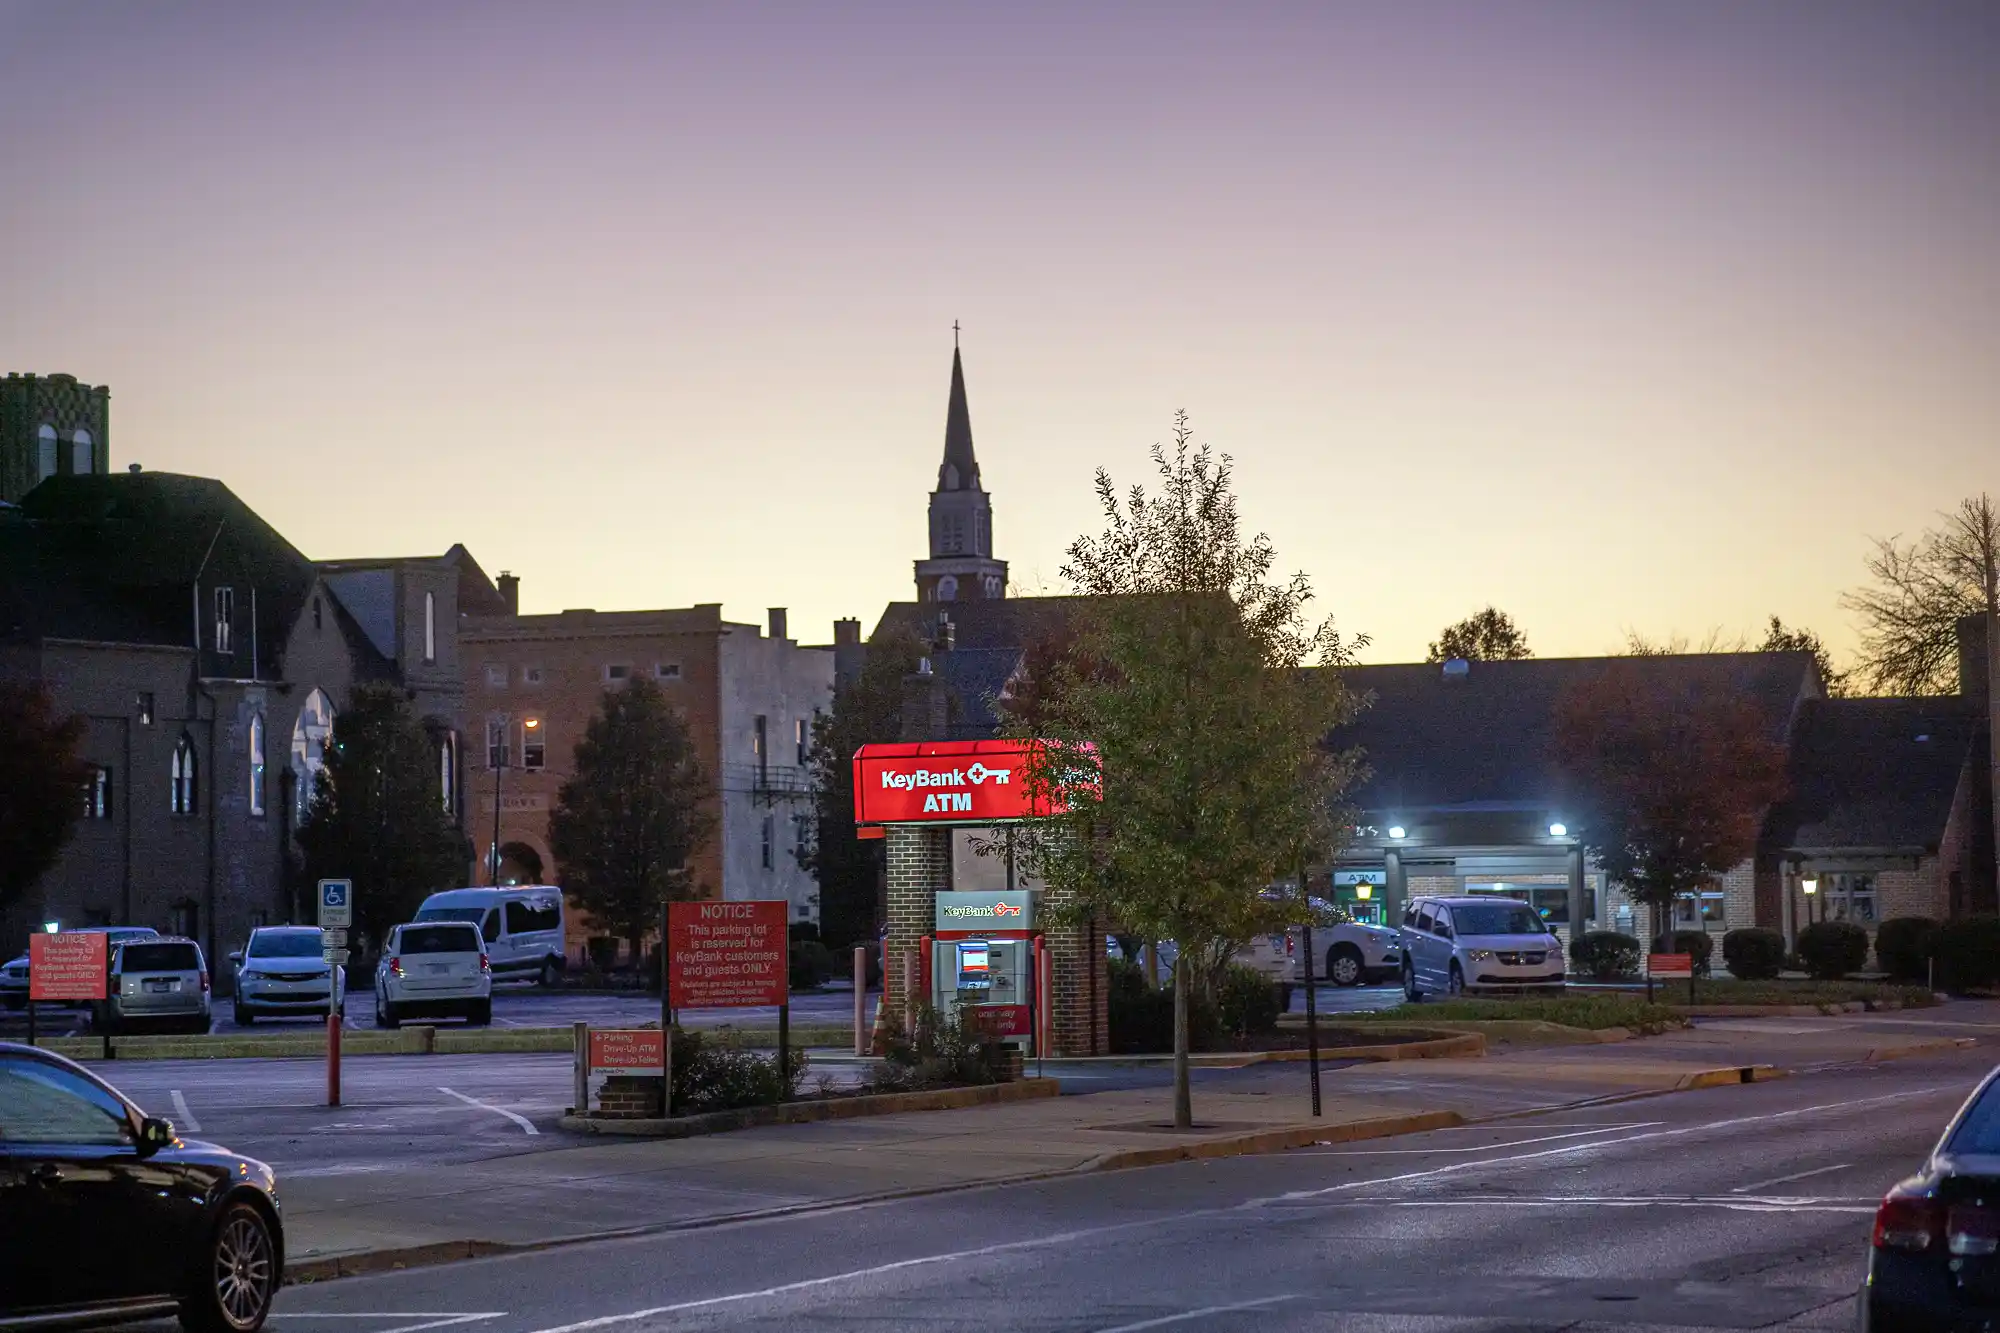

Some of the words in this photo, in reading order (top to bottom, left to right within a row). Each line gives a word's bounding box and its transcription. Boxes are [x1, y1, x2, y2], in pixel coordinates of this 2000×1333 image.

[881, 769, 966, 791] KeyBank
[923, 793, 972, 813] ATM
[1348, 874, 1377, 882] ATM
[701, 904, 755, 918] NOTICE
[944, 905, 994, 919] KeyBank
[688, 925, 709, 935] This
[713, 924, 751, 937] parking
[754, 924, 767, 934] lot
[51, 934, 87, 944] NOTICE
[691, 940, 700, 949] is
[703, 938, 747, 948] reserved
[750, 937, 764, 948] for
[676, 951, 721, 964] KeyBank
[725, 951, 779, 961] customers
[683, 965, 702, 976] and
[705, 965, 739, 977] guests
[742, 963, 773, 974] ONLY.
[603, 1033, 633, 1043] Parking
[603, 1044, 637, 1054] Drive-Up
[639, 1044, 656, 1052] ATM
[603, 1055, 637, 1065] Drive-Up
[639, 1055, 658, 1064] Teller
